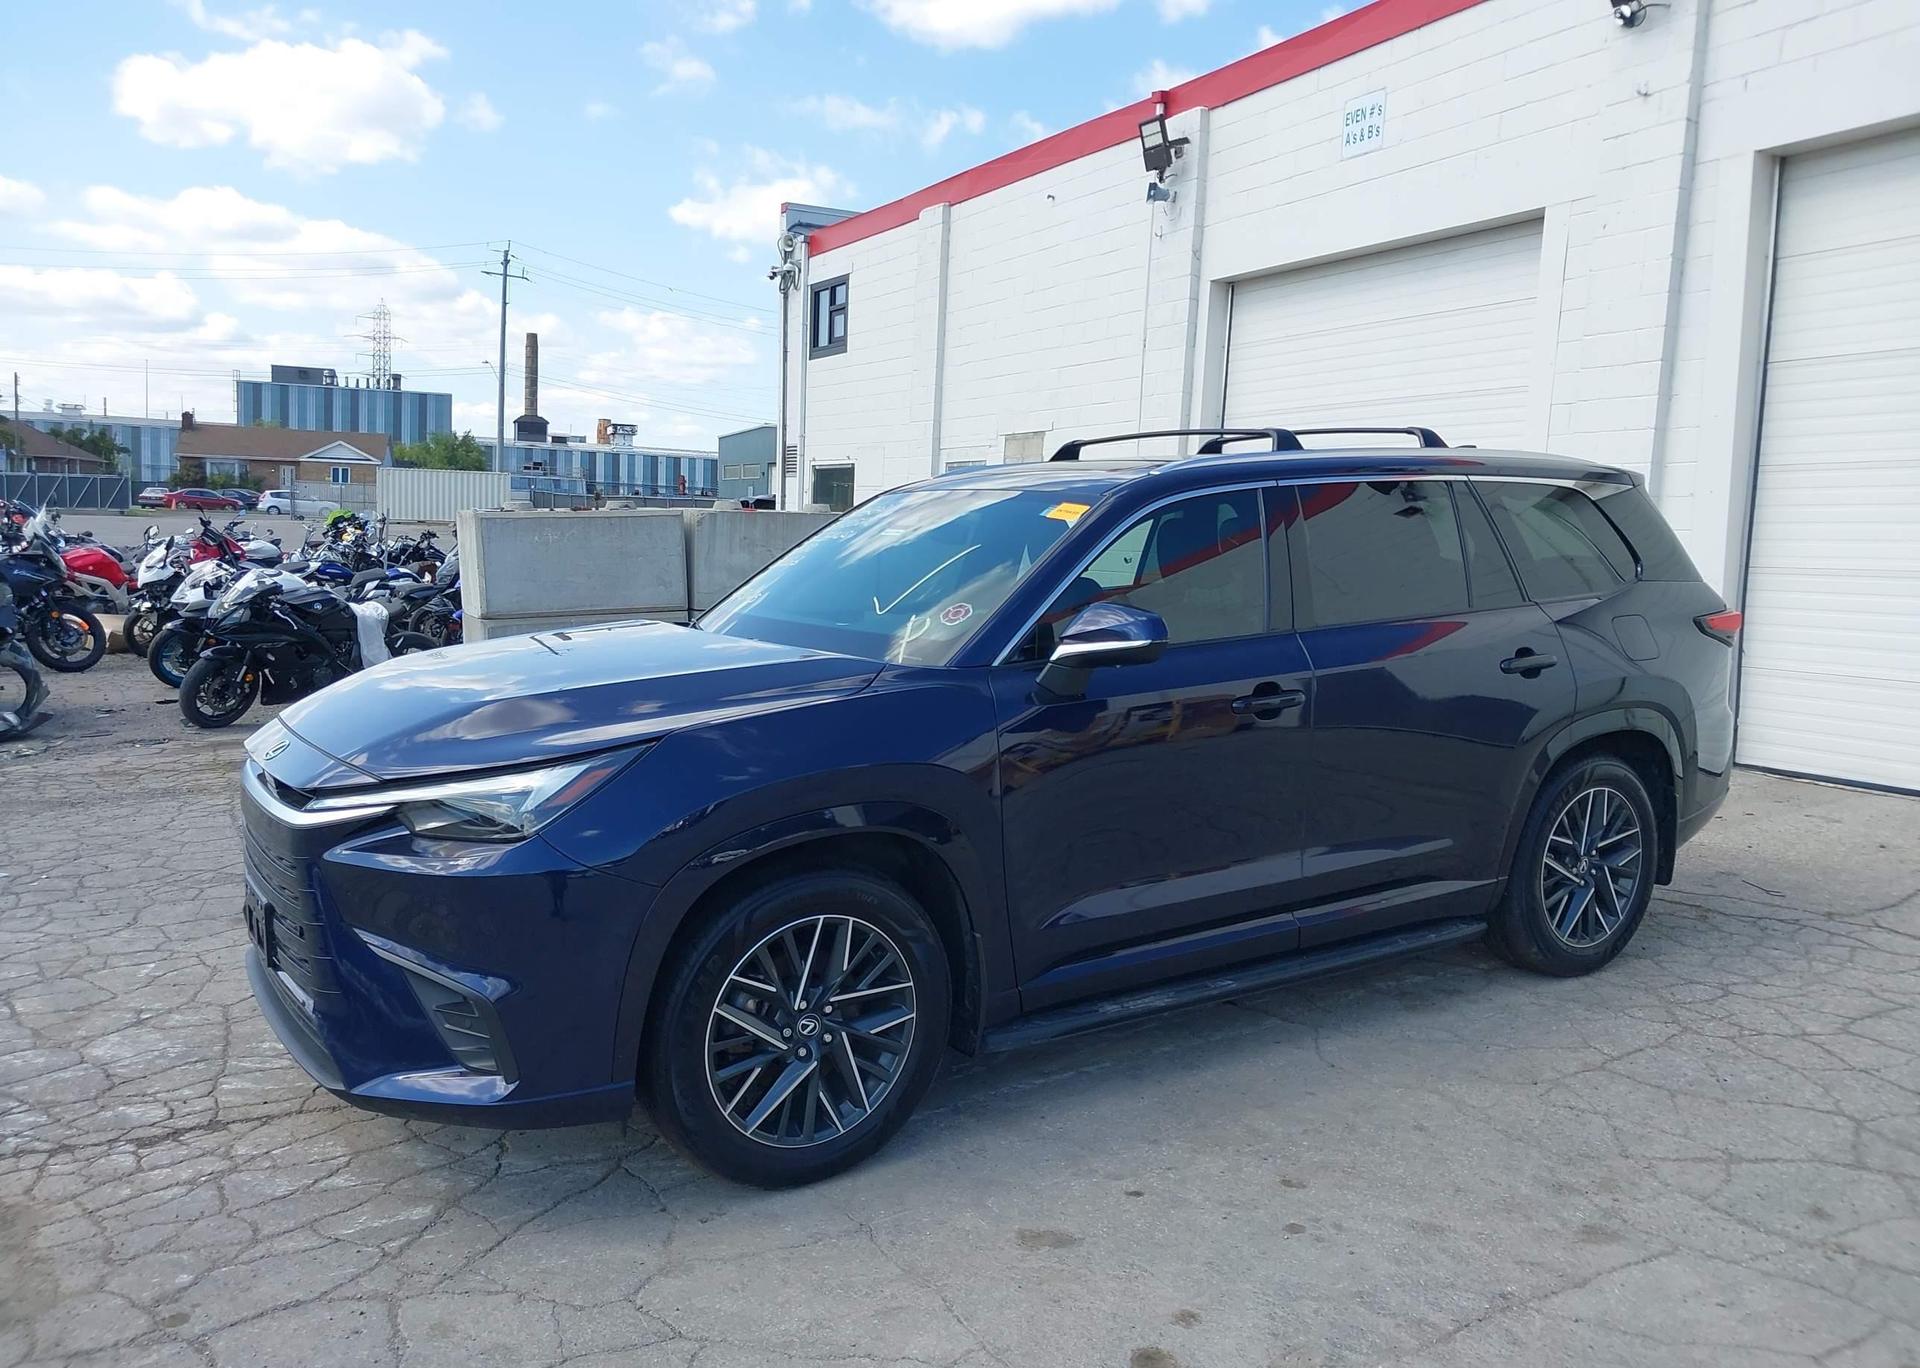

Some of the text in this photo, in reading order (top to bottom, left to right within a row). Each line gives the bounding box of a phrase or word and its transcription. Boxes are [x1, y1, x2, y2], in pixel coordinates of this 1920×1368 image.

[1345, 102, 1383, 127] EVEN #'s
[1345, 124, 1381, 147] A's & B's
